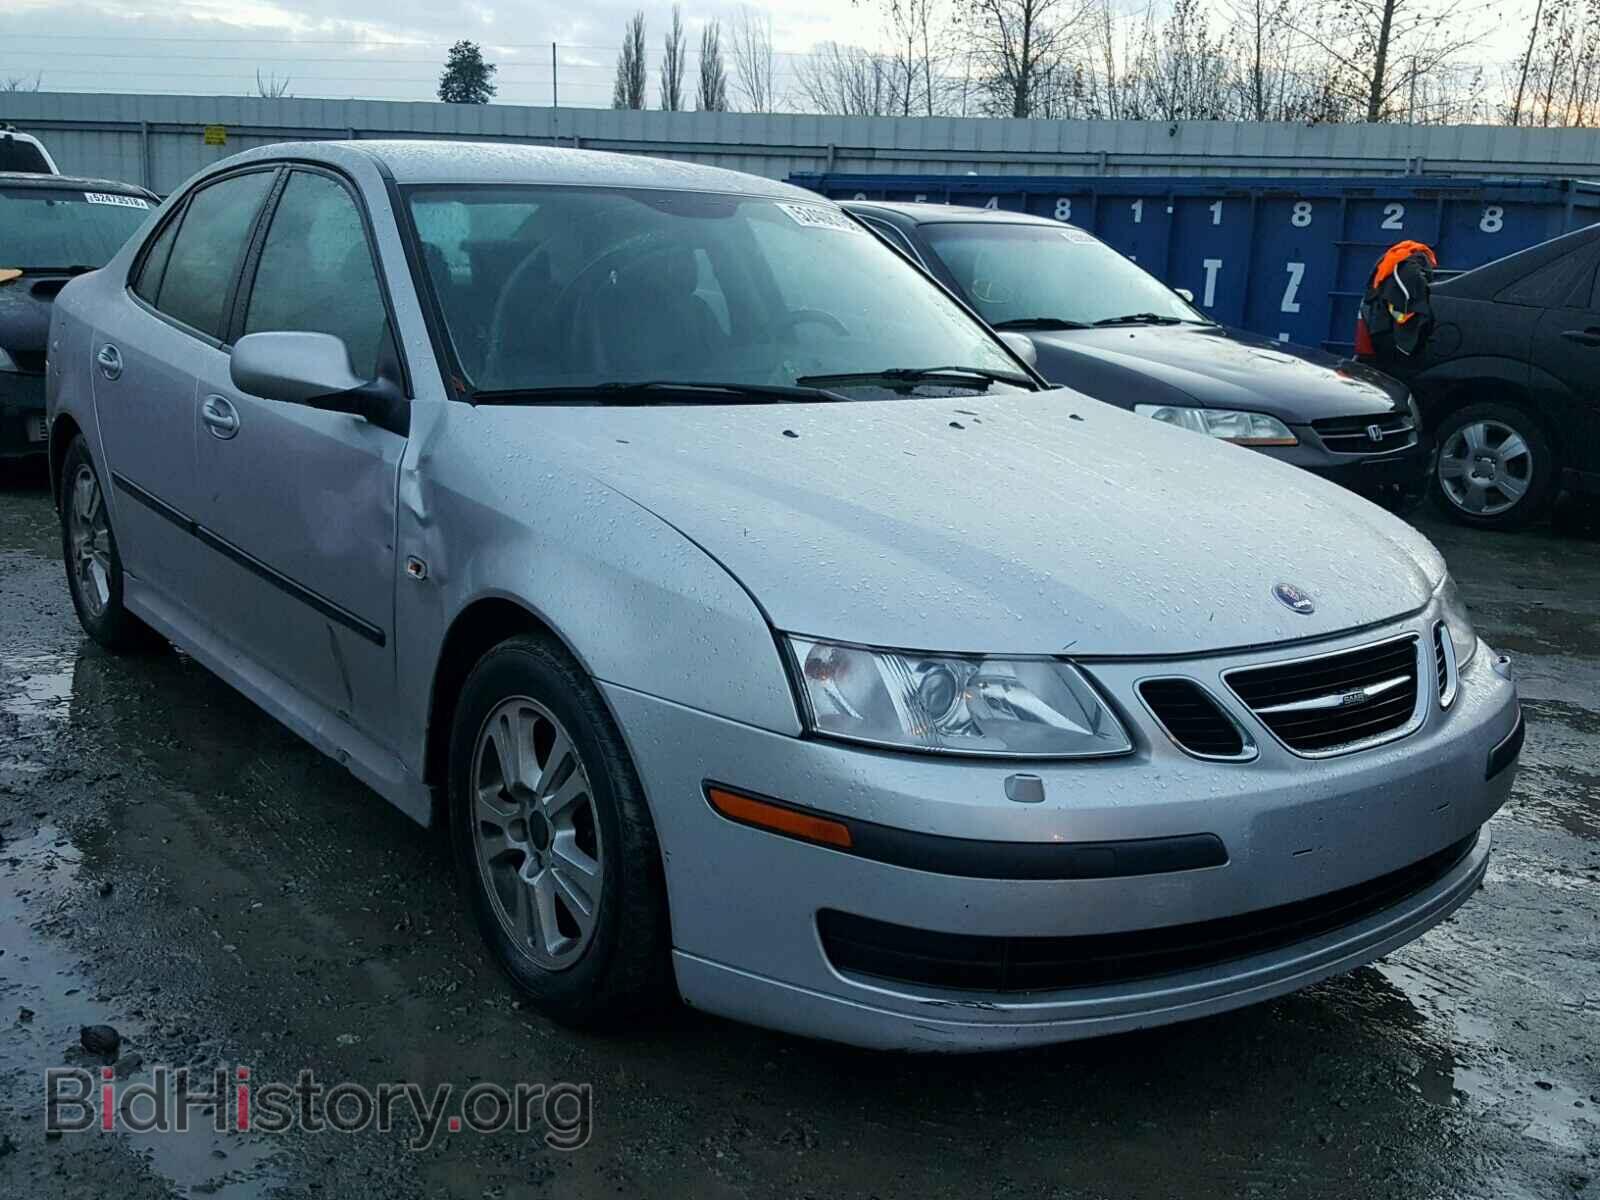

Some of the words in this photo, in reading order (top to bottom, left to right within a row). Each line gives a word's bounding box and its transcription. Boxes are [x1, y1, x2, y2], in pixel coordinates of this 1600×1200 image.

[1054, 198, 1071, 220] 8
[1131, 199, 1143, 223] 1
[1209, 200, 1223, 225] 1
[1291, 201, 1313, 227] 8
[1381, 203, 1405, 229] 2
[1479, 205, 1504, 233] 8
[1203, 259, 1223, 308] T
[1281, 262, 1305, 313] Z
